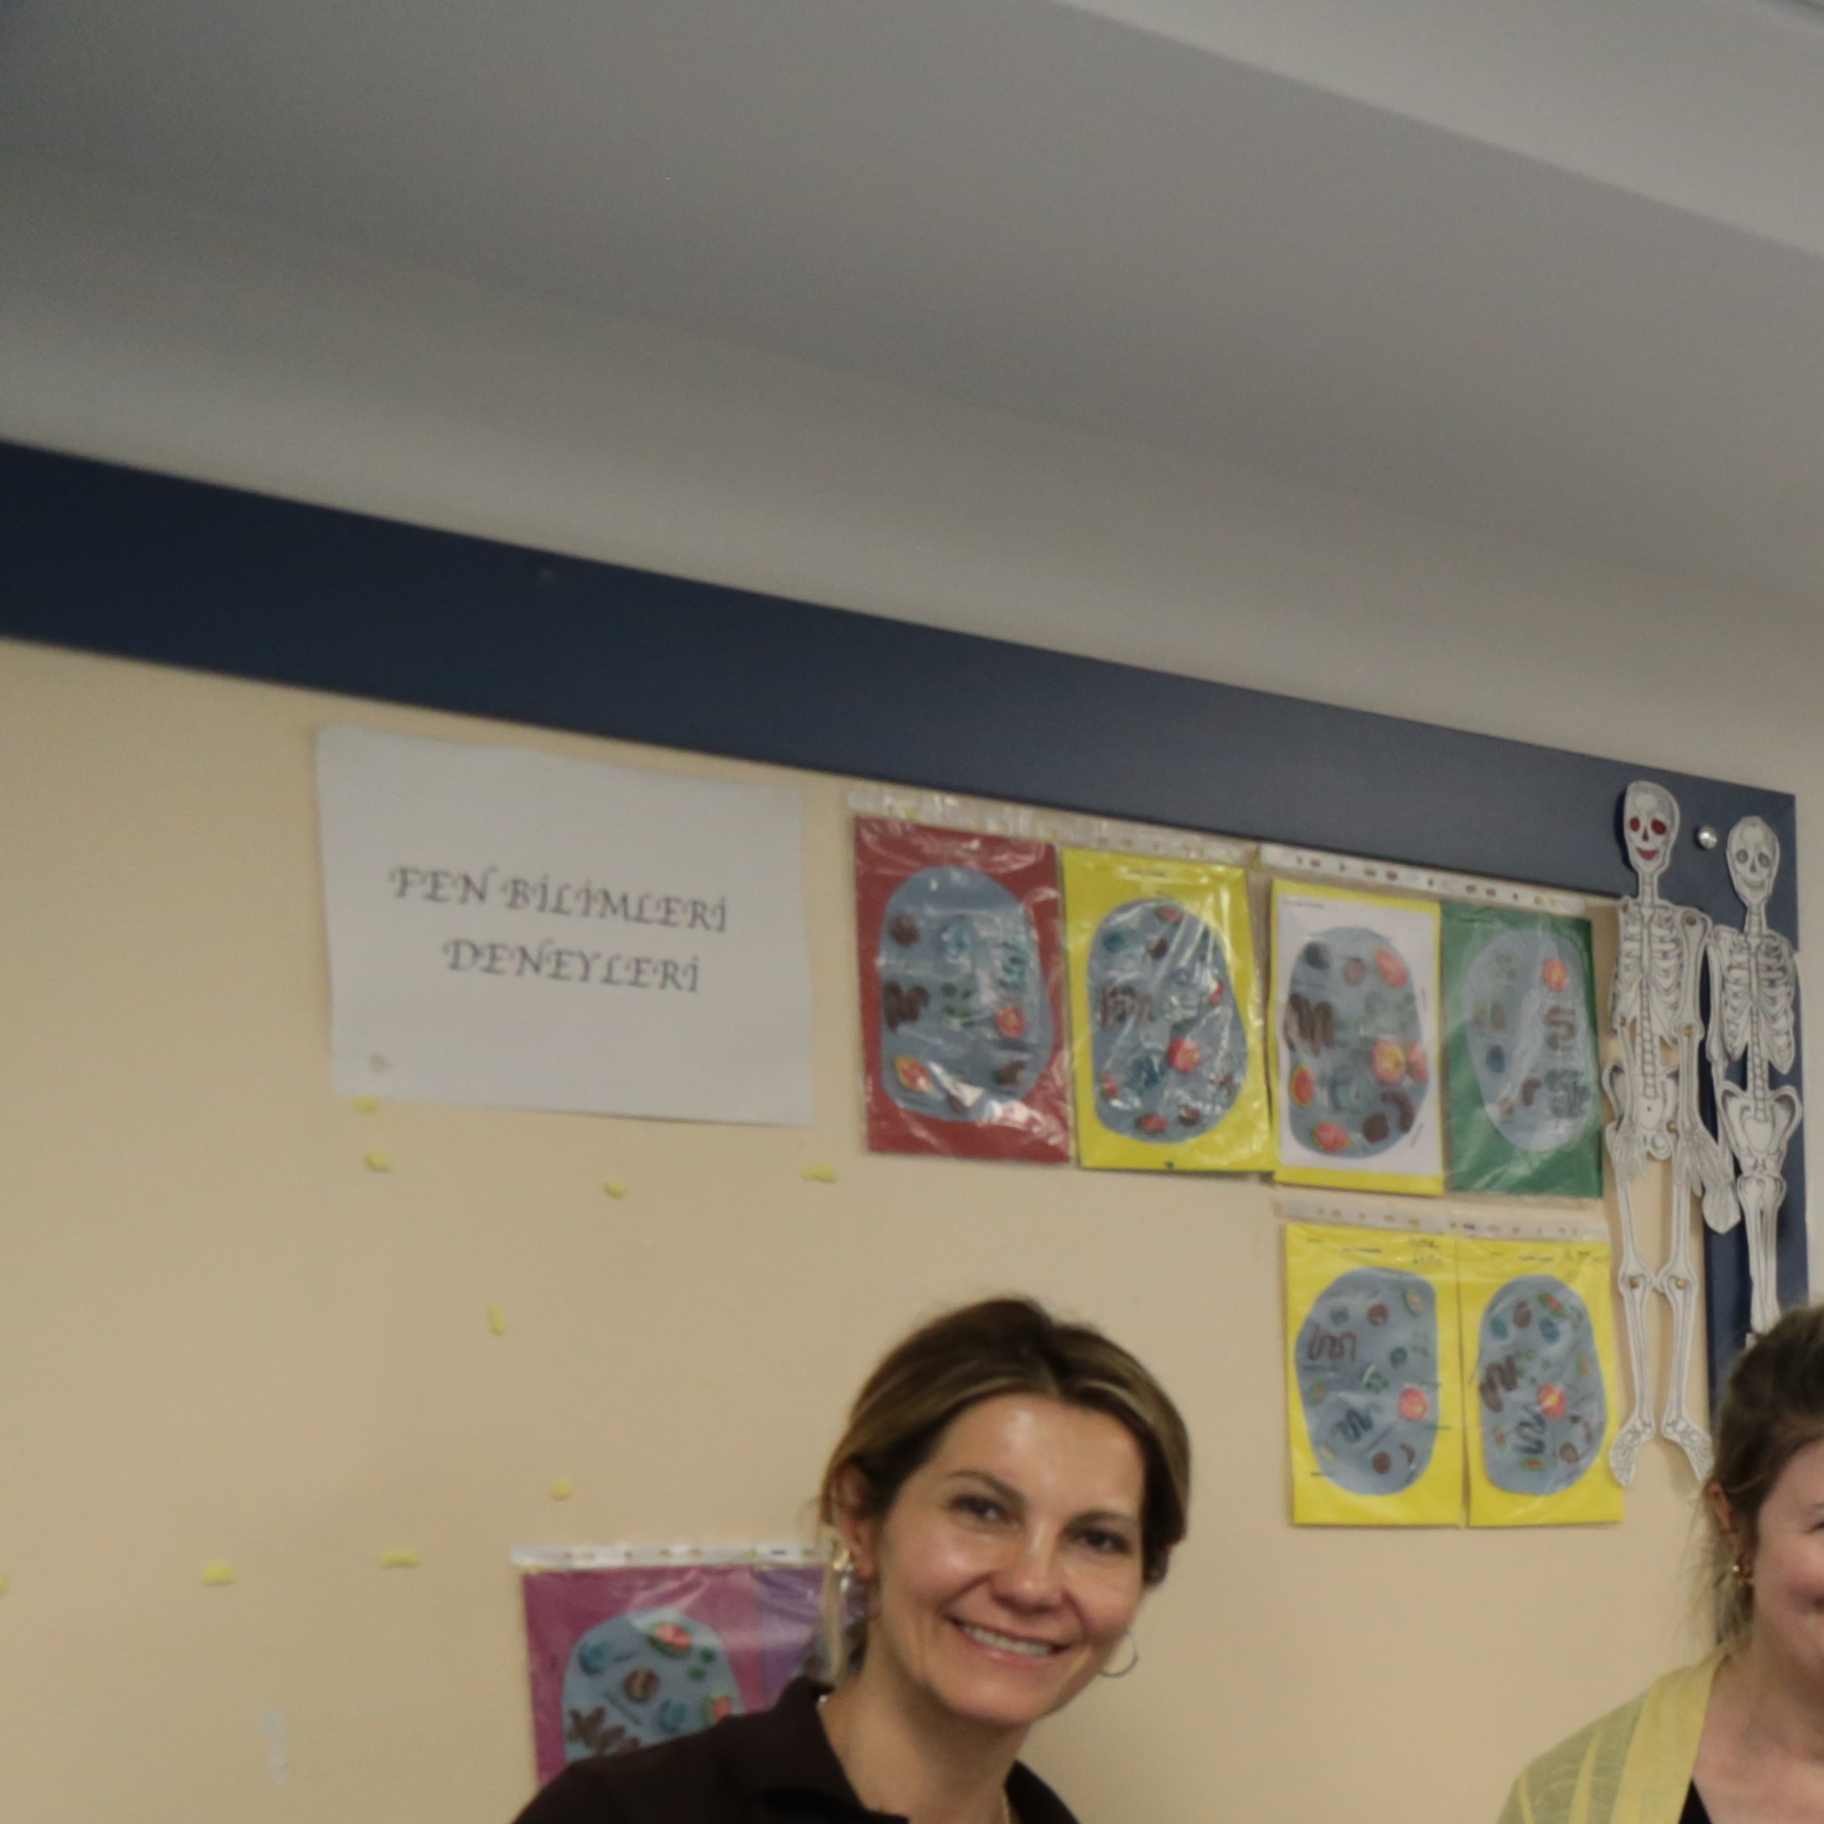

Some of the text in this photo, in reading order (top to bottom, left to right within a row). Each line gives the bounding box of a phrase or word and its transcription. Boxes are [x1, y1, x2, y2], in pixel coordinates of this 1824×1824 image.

[388, 866, 727, 932] FEN BİLİMLERİ
[443, 937, 699, 993] DENEYLERİ
